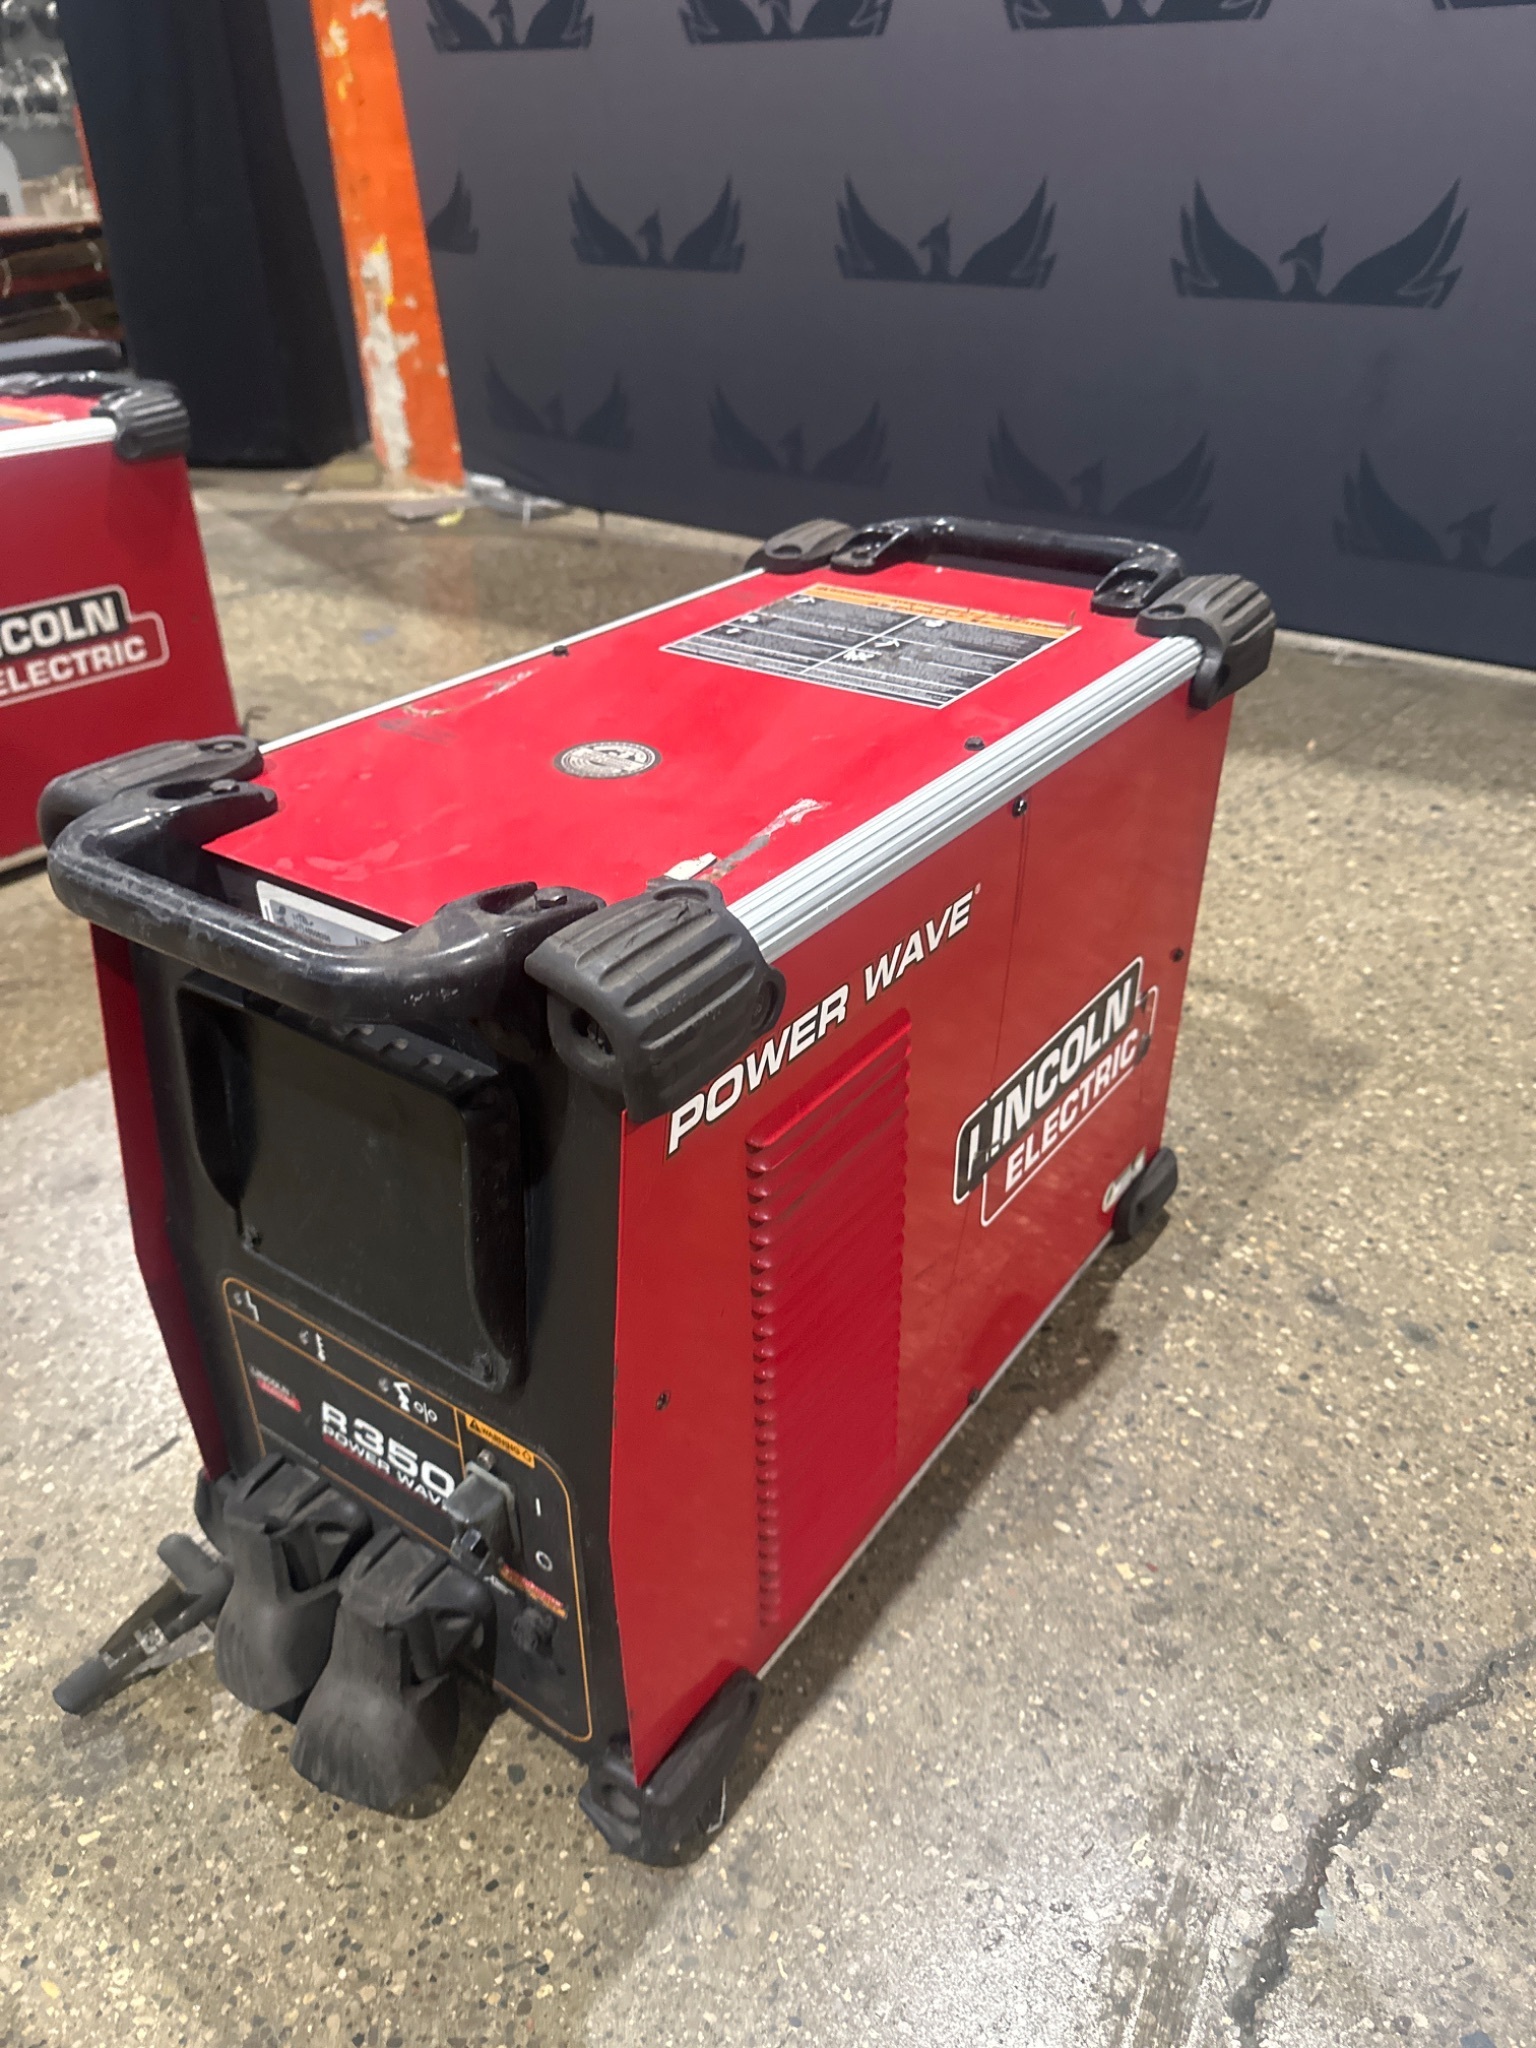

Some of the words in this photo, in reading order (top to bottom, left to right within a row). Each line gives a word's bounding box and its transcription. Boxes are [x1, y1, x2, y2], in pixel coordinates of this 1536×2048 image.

[667, 983, 850, 1157] POWER
[863, 889, 975, 1002] WAVE
[966, 977, 1132, 1182] LINCOLN
[1004, 1027, 1139, 1193] ELECTRIC
[322, 1422, 391, 1475] POWER
[396, 1470, 448, 1512] WAV
